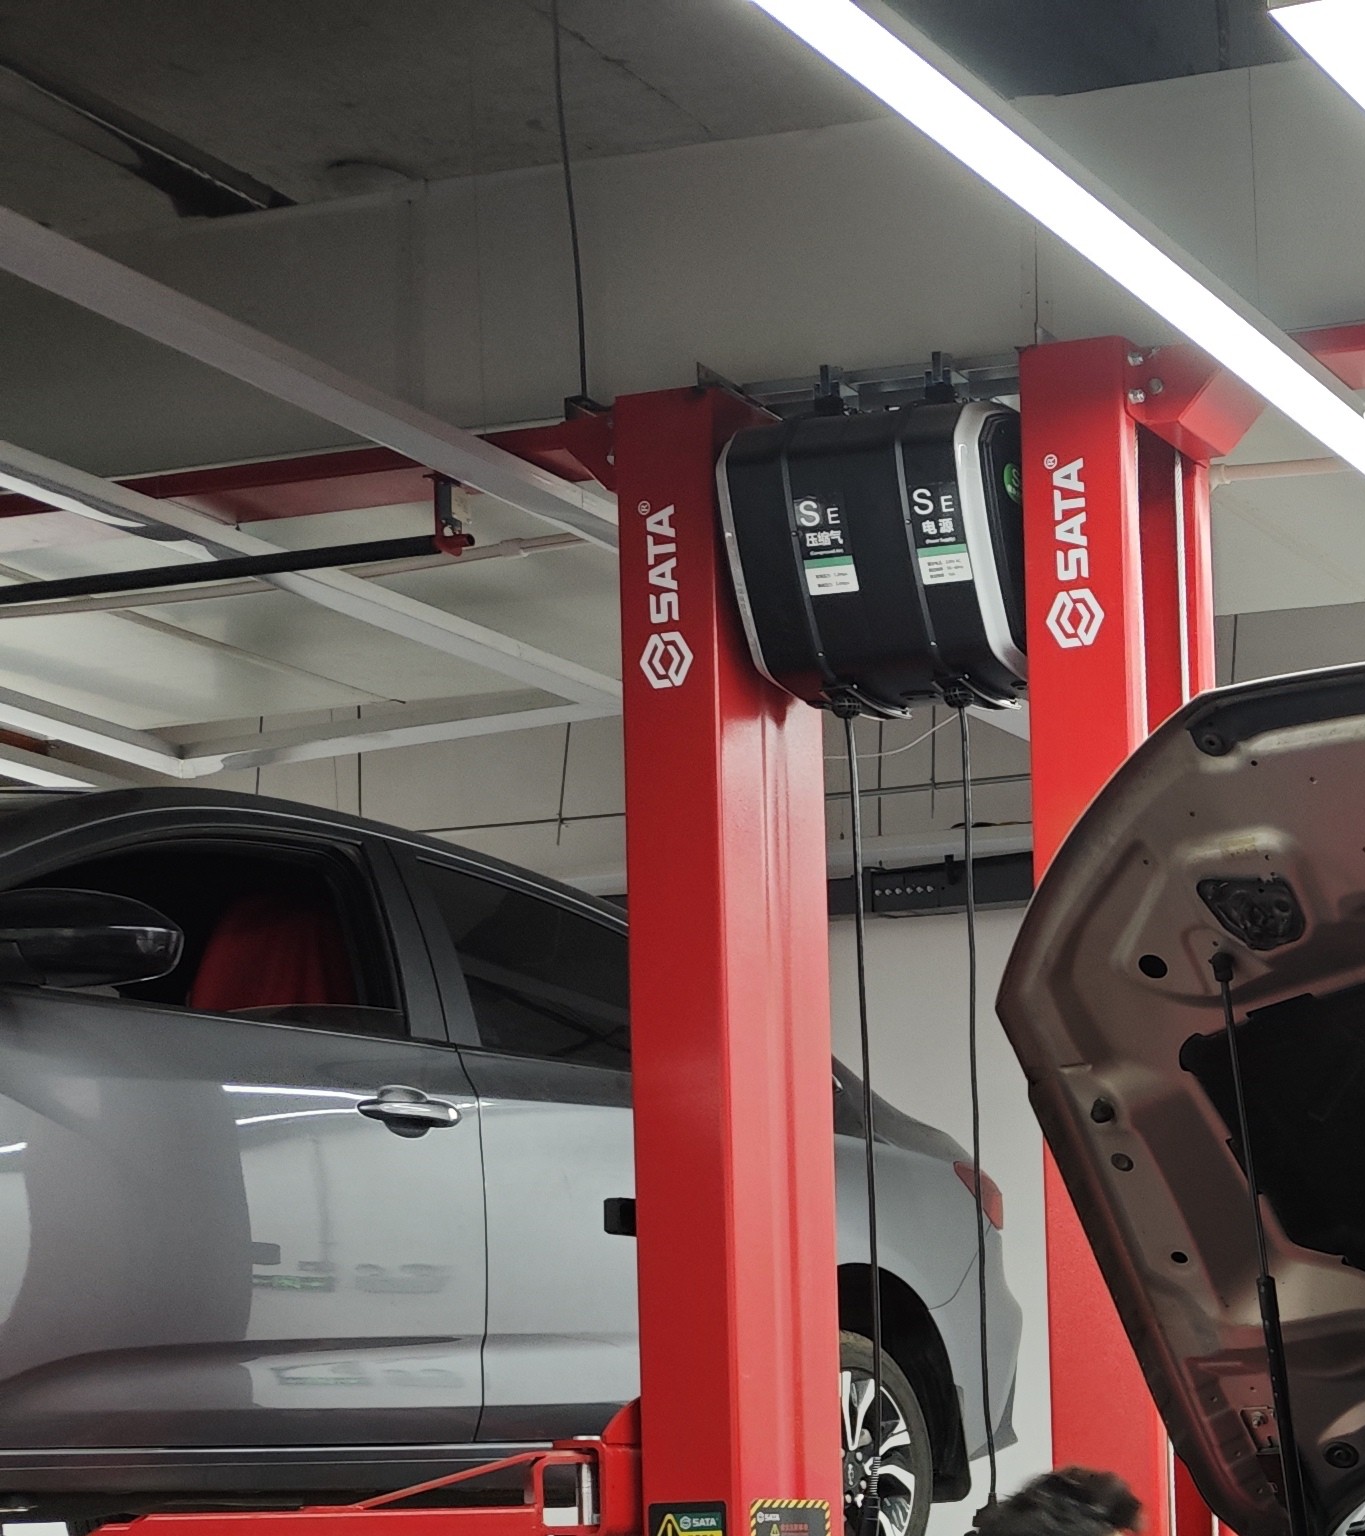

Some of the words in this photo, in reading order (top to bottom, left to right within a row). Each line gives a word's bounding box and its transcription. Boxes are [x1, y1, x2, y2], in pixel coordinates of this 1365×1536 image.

[921, 518, 955, 535] 电源
[1052, 457, 1090, 581] SATA
[805, 529, 844, 547] 压缩气
[646, 504, 680, 624] SATA
[692, 1517, 717, 1528] SATA
